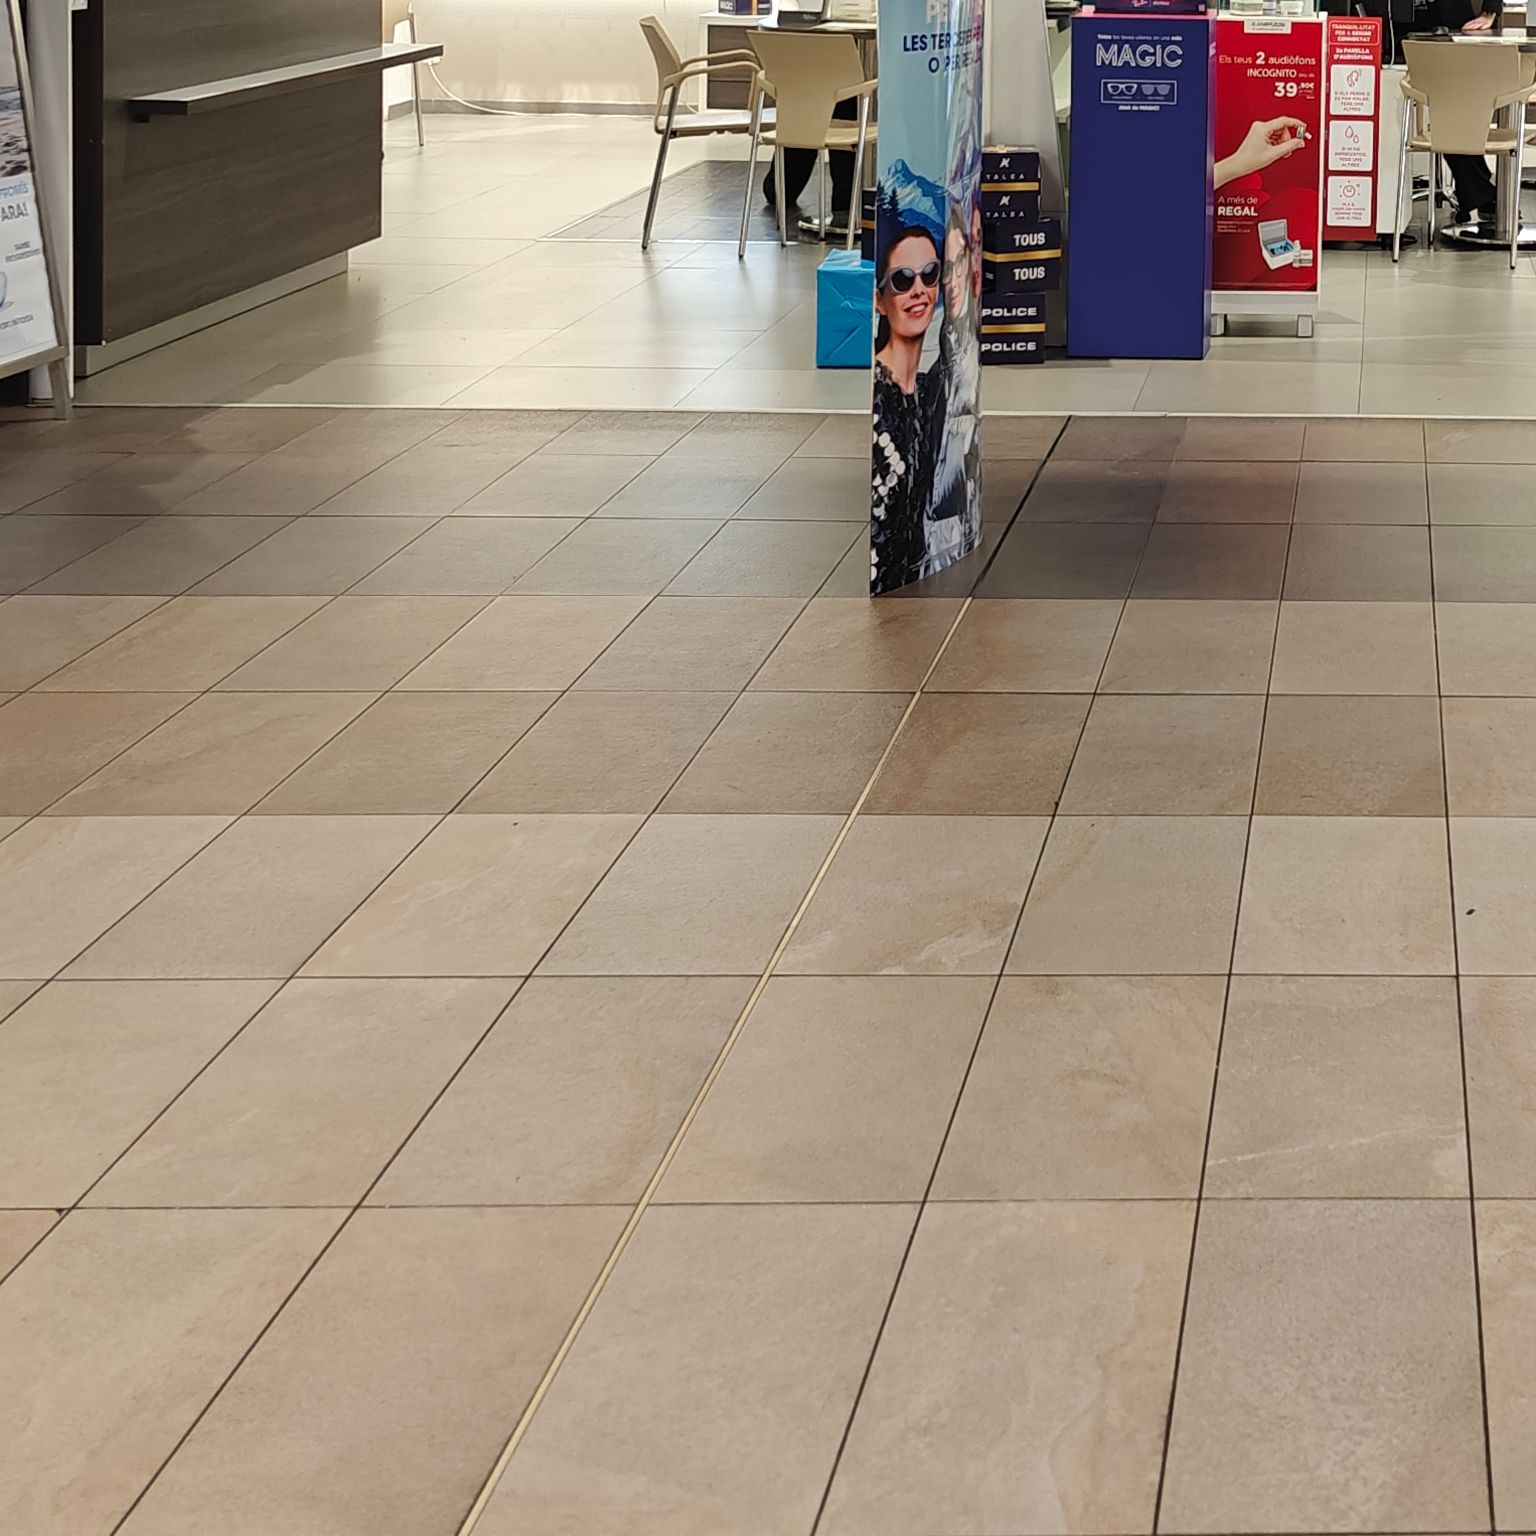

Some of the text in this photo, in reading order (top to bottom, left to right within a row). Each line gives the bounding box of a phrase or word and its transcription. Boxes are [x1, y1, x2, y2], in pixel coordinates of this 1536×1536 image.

[903, 33, 929, 53] LES
[1095, 43, 1183, 68] MAGIC
[1219, 51, 1316, 65] Els teus 2 audiòfons
[928, 56, 940, 74] O
[1247, 68, 1297, 78] INCOGNITO
[1217, 195, 1258, 204] A més de
[1217, 206, 1258, 217] REGAL
[1013, 232, 1046, 247] TOUS
[1013, 266, 1046, 281] TOUS
[981, 307, 1038, 317] POLICE
[980, 342, 1037, 352] POLICE
